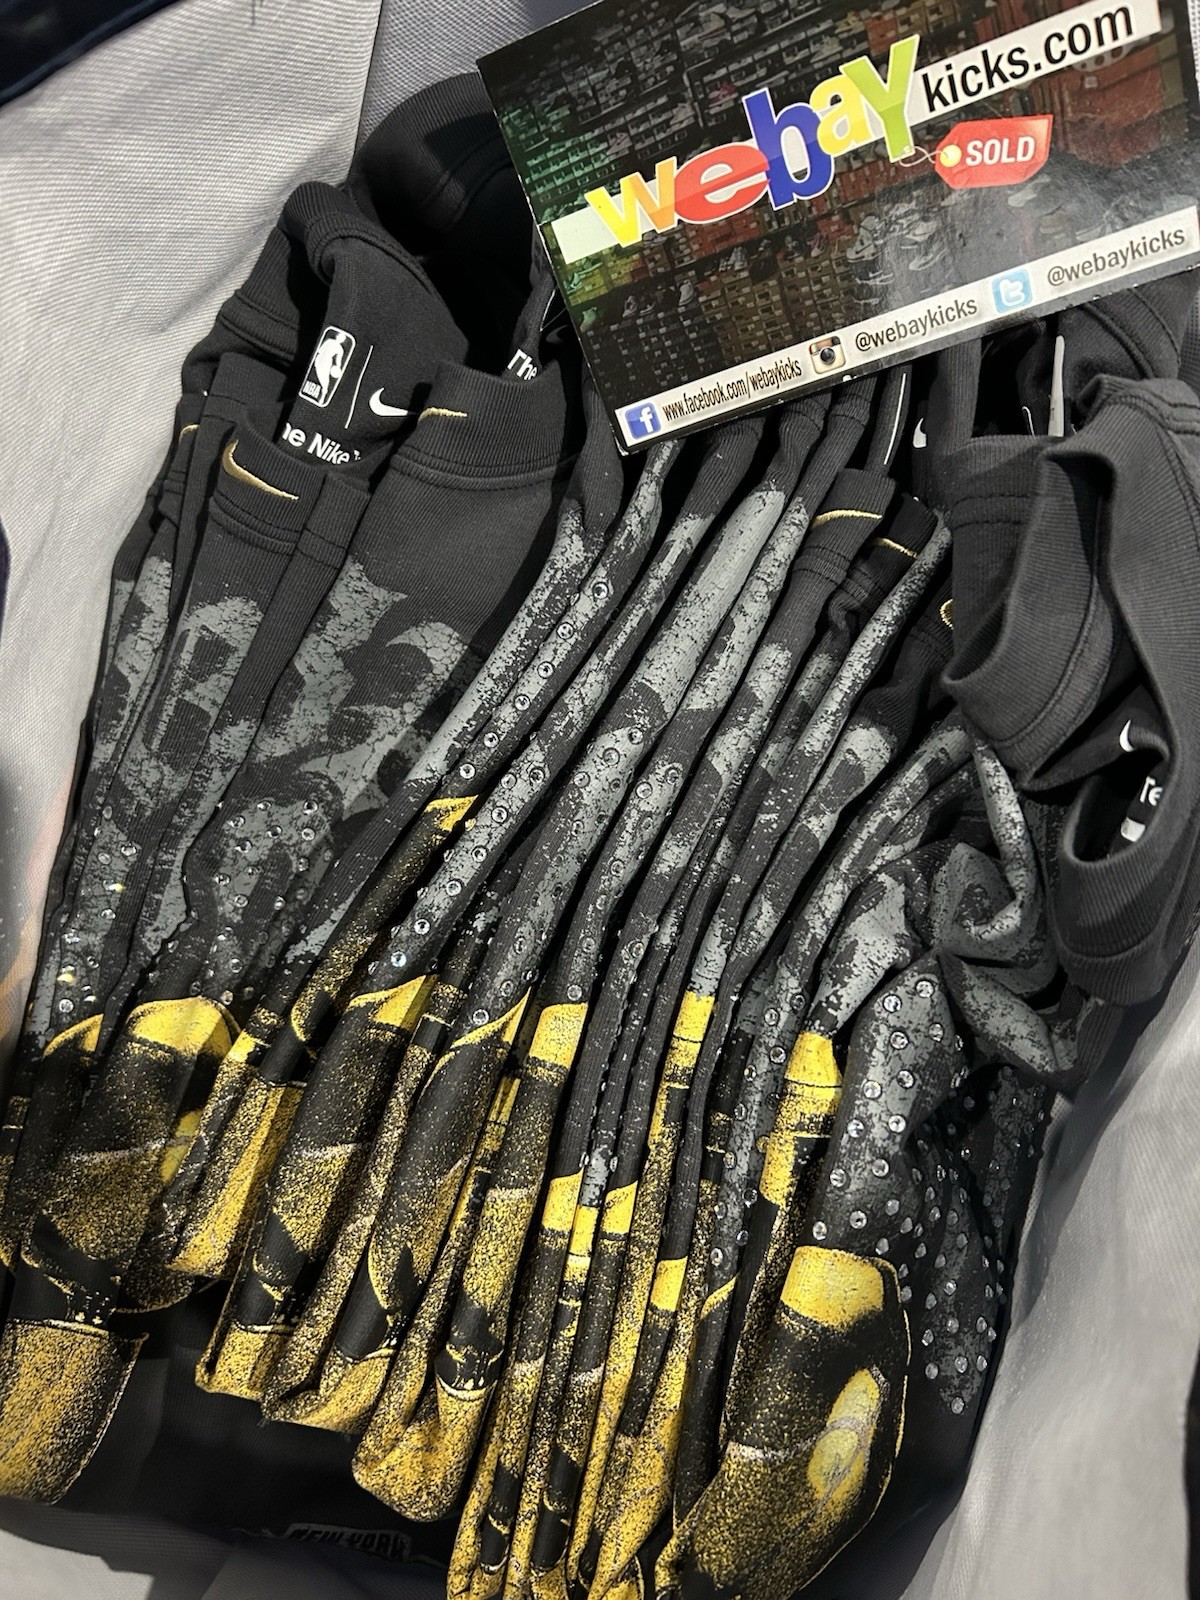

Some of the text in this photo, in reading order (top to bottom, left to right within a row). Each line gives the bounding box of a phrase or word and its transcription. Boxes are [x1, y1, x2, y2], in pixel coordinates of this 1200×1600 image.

[965, 136, 1036, 167] SOLD
[1047, 228, 1186, 287] @webaykicks
[854, 297, 978, 352] @webaykicks
[302, 380, 321, 399] NBA
[662, 357, 802, 422] www.facebook.com/webaykicks
[307, 432, 350, 465] Nike
